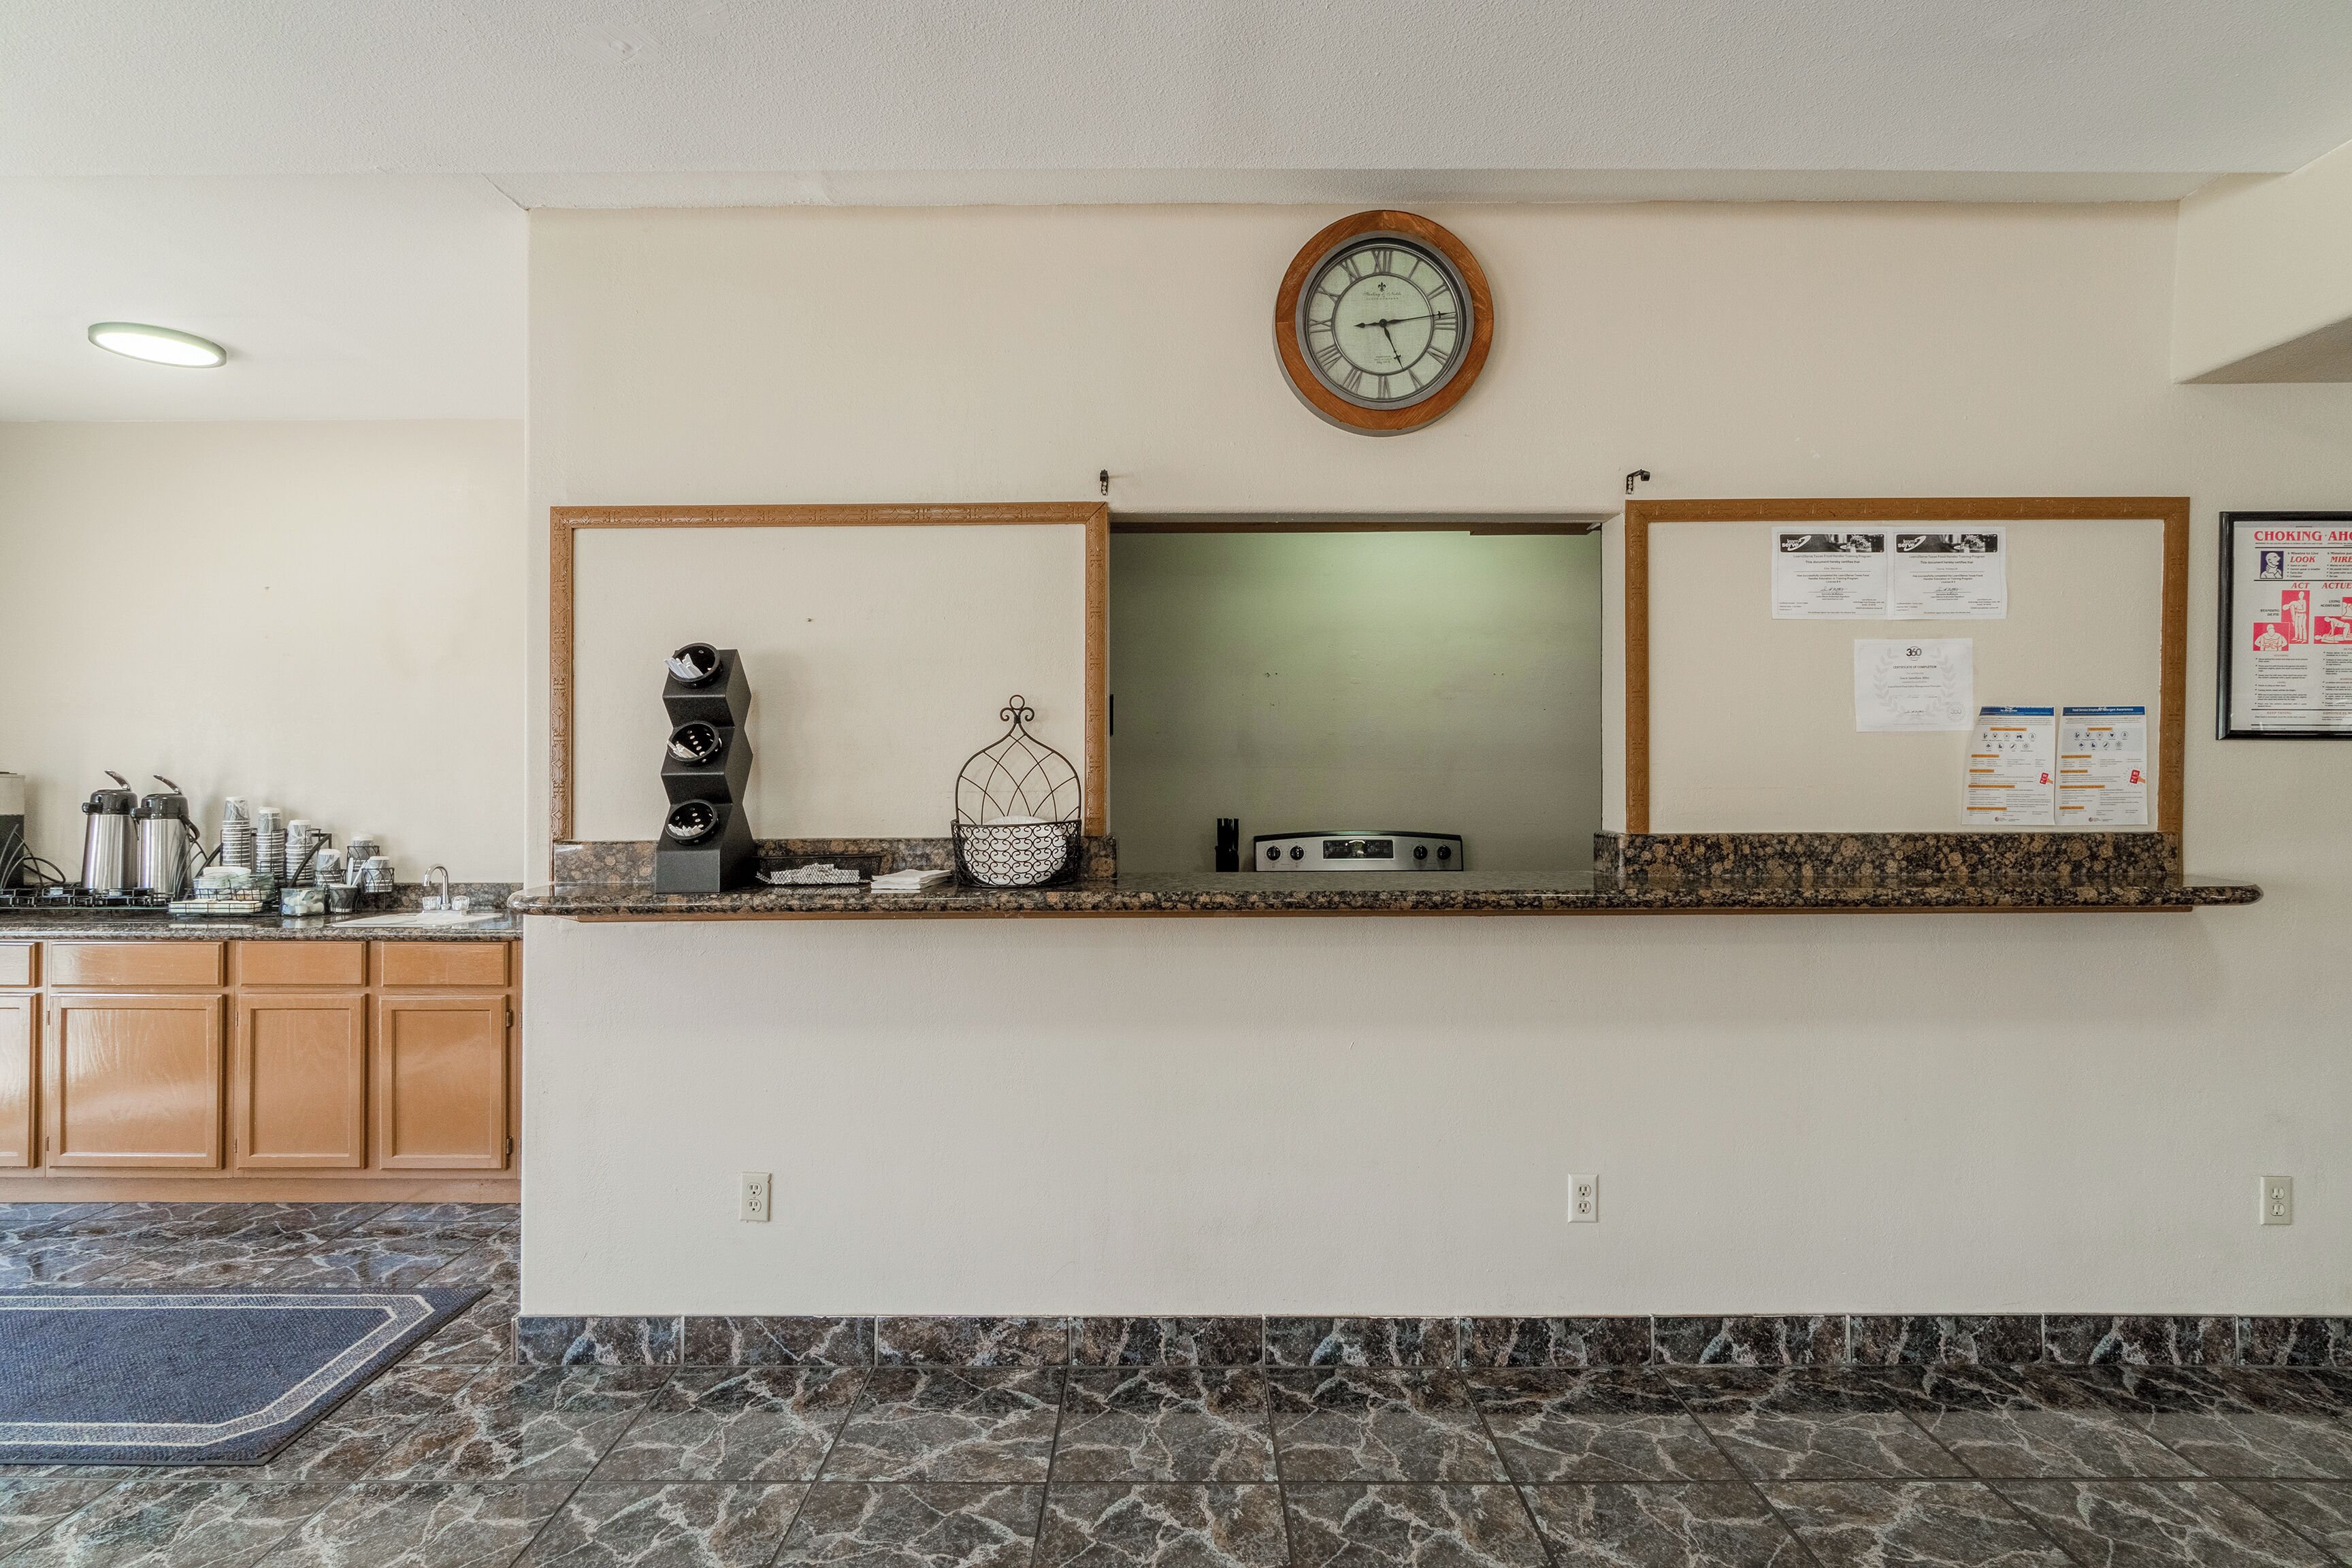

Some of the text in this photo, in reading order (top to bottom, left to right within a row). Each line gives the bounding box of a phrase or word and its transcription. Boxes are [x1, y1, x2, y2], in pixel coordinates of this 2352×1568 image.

[2254, 531, 2352, 541] CHOKING AH
[1906, 648, 1922, 656] 360
